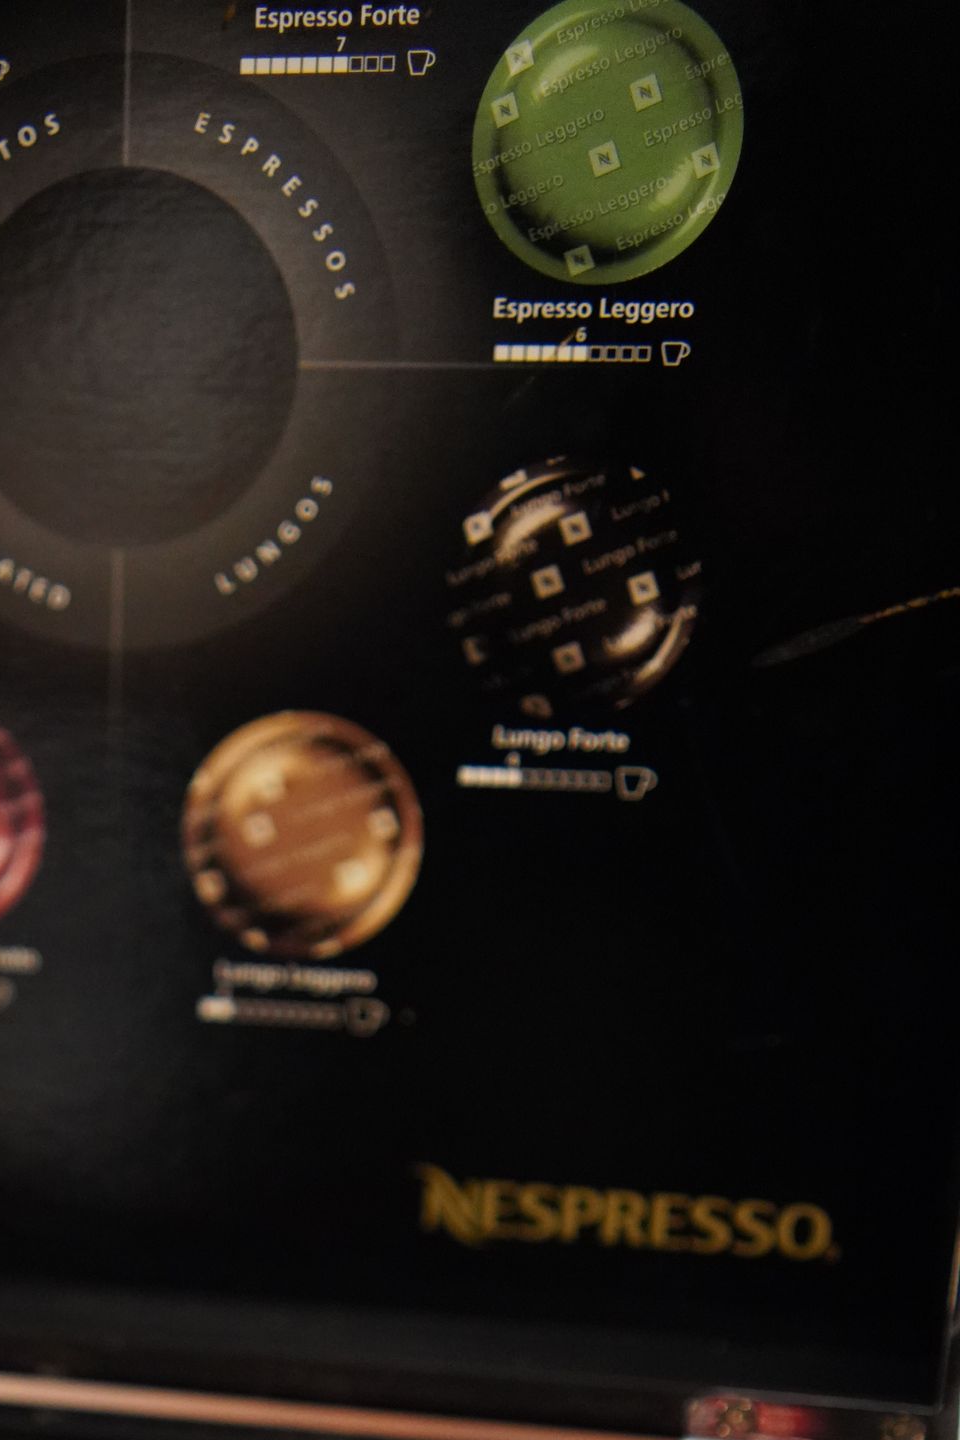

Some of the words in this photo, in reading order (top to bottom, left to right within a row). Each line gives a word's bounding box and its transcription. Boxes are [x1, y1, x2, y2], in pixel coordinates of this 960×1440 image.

[254, 6, 353, 31] Espresso
[360, 4, 420, 27] Forte
[555, 8, 626, 45] Espresso
[336, 36, 347, 52] 7
[540, 58, 611, 98] Espresso
[614, 26, 683, 65] Leggero
[536, 107, 605, 148] Leggero
[643, 108, 713, 148] Espresso
[192, 112, 356, 300] ESPRESSOS
[499, 174, 565, 211] Leggero
[527, 209, 595, 244] Espresso
[597, 175, 666, 216] Leggero
[615, 212, 685, 251] Espresso
[493, 297, 593, 323] Espresso
[599, 297, 695, 323] Leggero
[575, 326, 587, 343] 6
[214, 475, 333, 595] LUNGOS
[492, 725, 566, 755] Lungo
[568, 726, 630, 752] Forte
[414, 1161, 833, 1260] NESPRESSO
